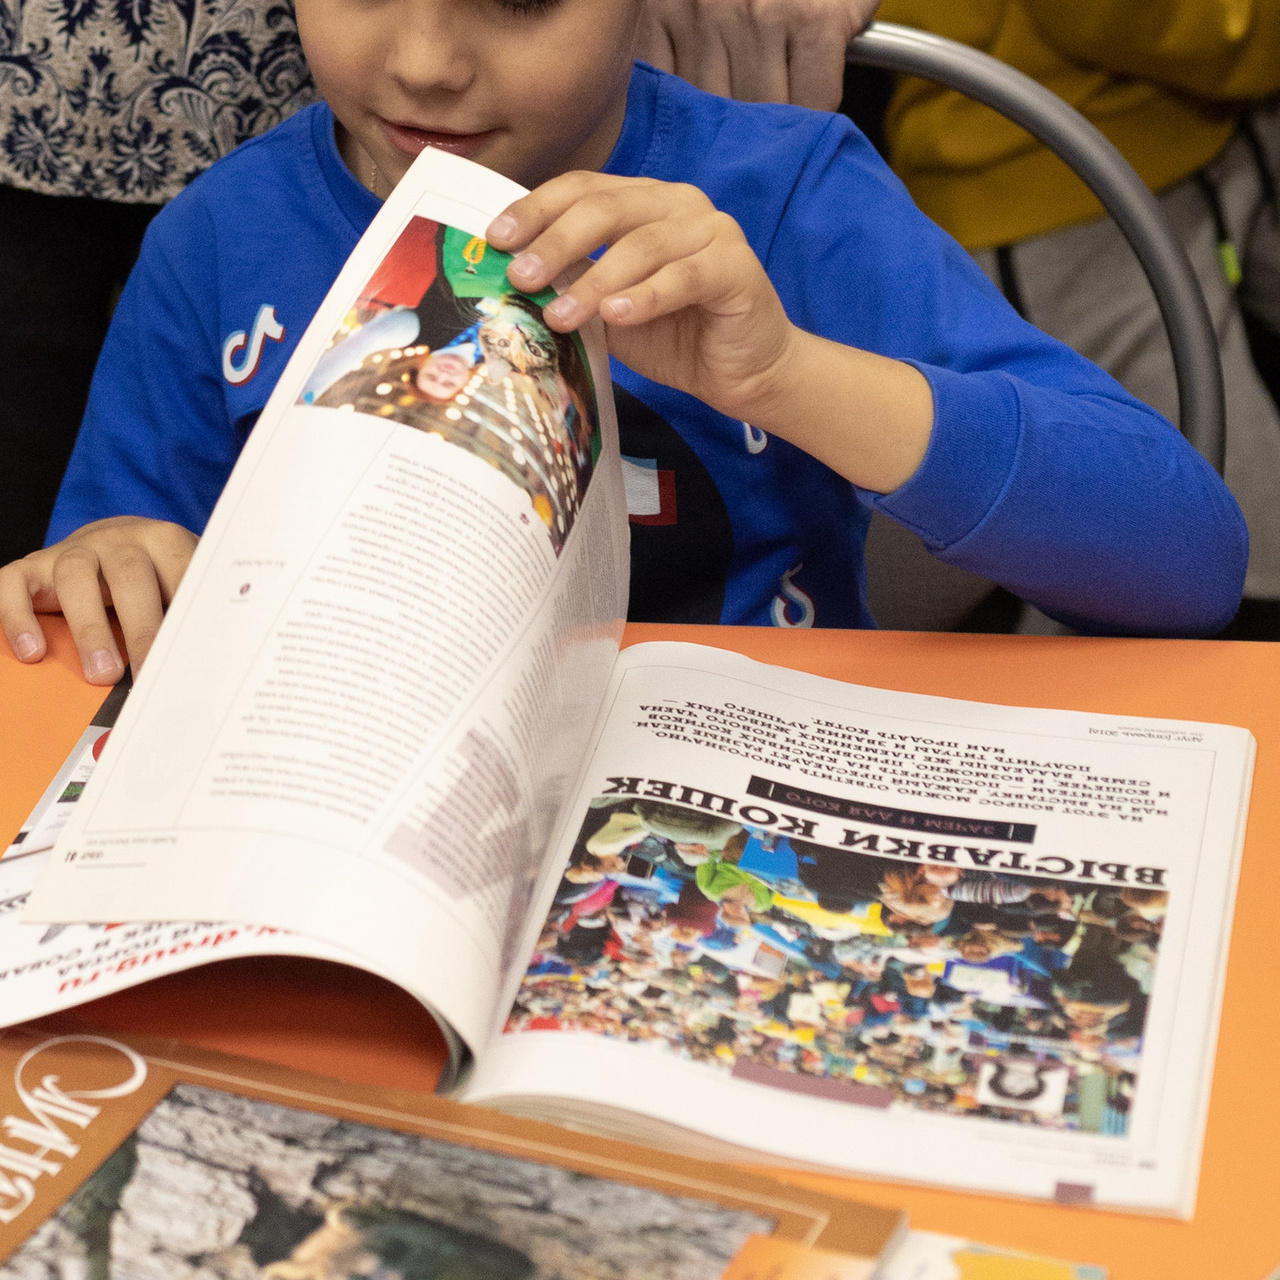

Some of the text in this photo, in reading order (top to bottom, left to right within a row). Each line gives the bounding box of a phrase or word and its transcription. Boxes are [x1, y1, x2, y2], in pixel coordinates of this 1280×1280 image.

[638, 704, 698, 719] ЧЛЕНА
[684, 700, 792, 734] ЖИВОТНЫХ
[632, 720, 686, 738] ЦЕЛИ.
[648, 713, 732, 735] КОТИКОВ
[705, 714, 780, 738] НОВОГО
[692, 729, 764, 755] РАЗНЫЕ
[724, 702, 1091, 773] ПОЛУЧИТЬ ТИТУЛЫ И ЗВАНИЯ ЛУЧШЕГО
[798, 732, 915, 761] ПЛЕМЕННЫХ
[810, 717, 1005, 755] ИЛИ ПРОДАТЬ КОТЯТ.
[738, 733, 838, 765] КРАСИВЫХ
[786, 734, 904, 768] ПРИОБРЕСТИ
[922, 755, 951, 764] ЖЕ
[770, 750, 884, 782] ПРЕСЛЕДУЕТ
[844, 758, 870, 770] НА
[912, 761, 1024, 783] ВОЗМОЖНО,
[958, 759, 1073, 780] ВЛАДЕЛЬЦЫ
[651, 730, 1143, 823] НА ЭТОТ ВОПРОС МОЖНО ОТВЕТИТЬ МНОГОЗНАЧНО.
[877, 766, 999, 790] ПОСМОТРЕТЬ
[890, 776, 978, 796] КАЖДЫЙ
[1032, 777, 1044, 785] И
[1081, 773, 1151, 787] СЕМЬИ.
[784, 792, 842, 814] КОГО
[1031, 786, 1156, 807] ПОСЕТИТЕЛИ
[1157, 790, 1171, 798] И
[1096, 803, 1122, 812] НА
[1130, 806, 1169, 817] ИДЯ
[601, 777, 1168, 887] ВЫСТАВКИ КОШЕК
[925, 819, 996, 836] ЗАЧЕМ
